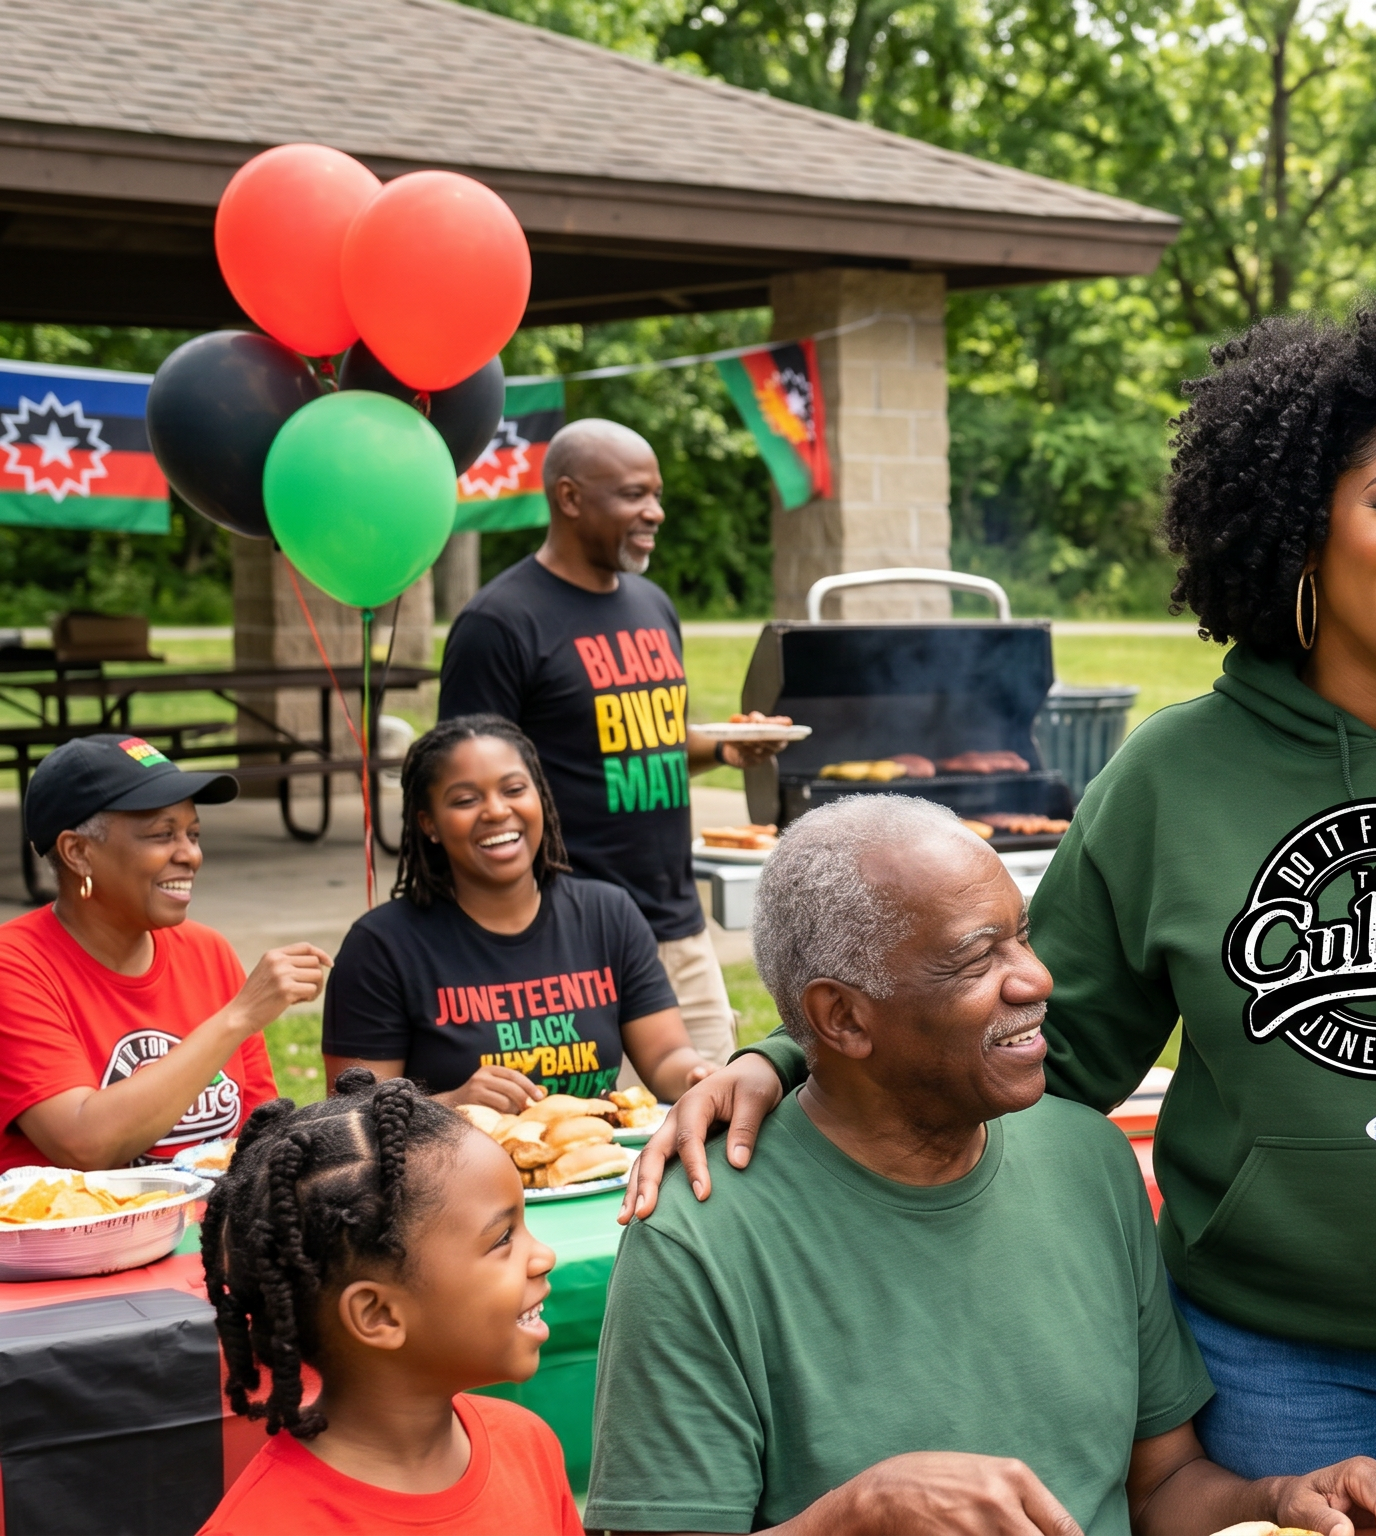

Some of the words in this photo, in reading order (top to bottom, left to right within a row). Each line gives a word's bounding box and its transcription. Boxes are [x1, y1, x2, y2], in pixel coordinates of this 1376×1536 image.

[574, 628, 684, 690] BLACK
[1277, 851, 1315, 889] DO
[1315, 823, 1345, 858] IT
[435, 966, 618, 1026] JUNETEENTH
[496, 1013, 581, 1051] BLACK
